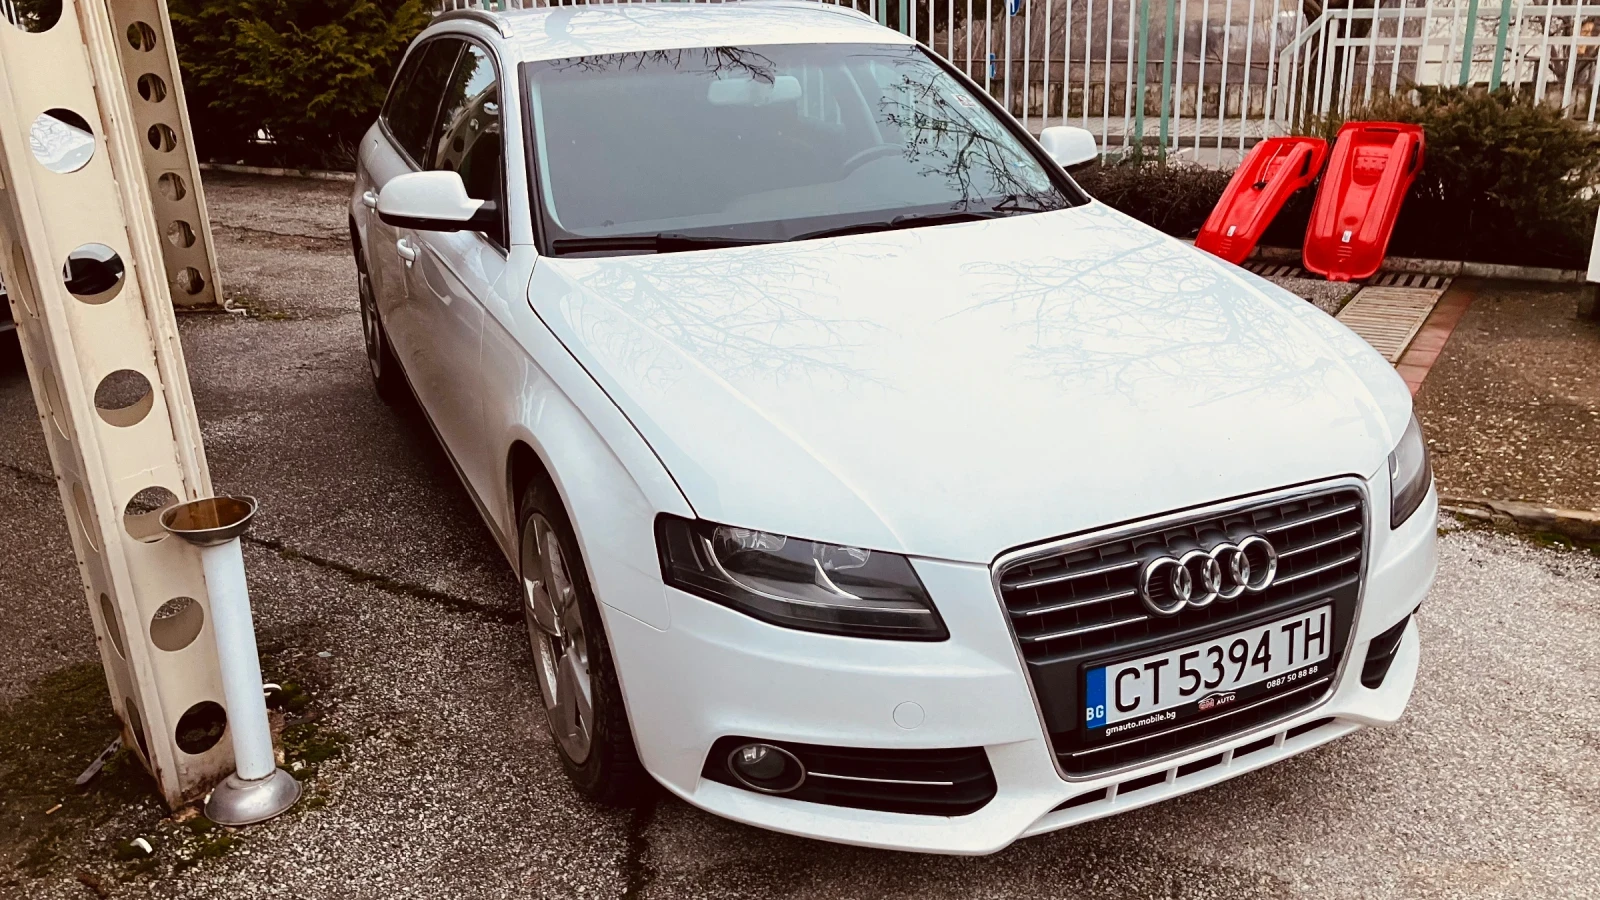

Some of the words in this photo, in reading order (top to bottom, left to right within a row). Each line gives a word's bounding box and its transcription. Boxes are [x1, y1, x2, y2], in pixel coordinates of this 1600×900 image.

[1115, 659, 1169, 712] CT
[1179, 630, 1272, 696] 5394
[1281, 613, 1326, 666] TH
[1266, 676, 1285, 689] 0887
[1287, 673, 1297, 683] 50
[1298, 669, 1308, 679] 88
[1308, 665, 1318, 675] 88
[1216, 694, 1236, 706] AUTO
[1086, 705, 1104, 721] BG
[1105, 711, 1176, 736] gmauto.mobile.bg
